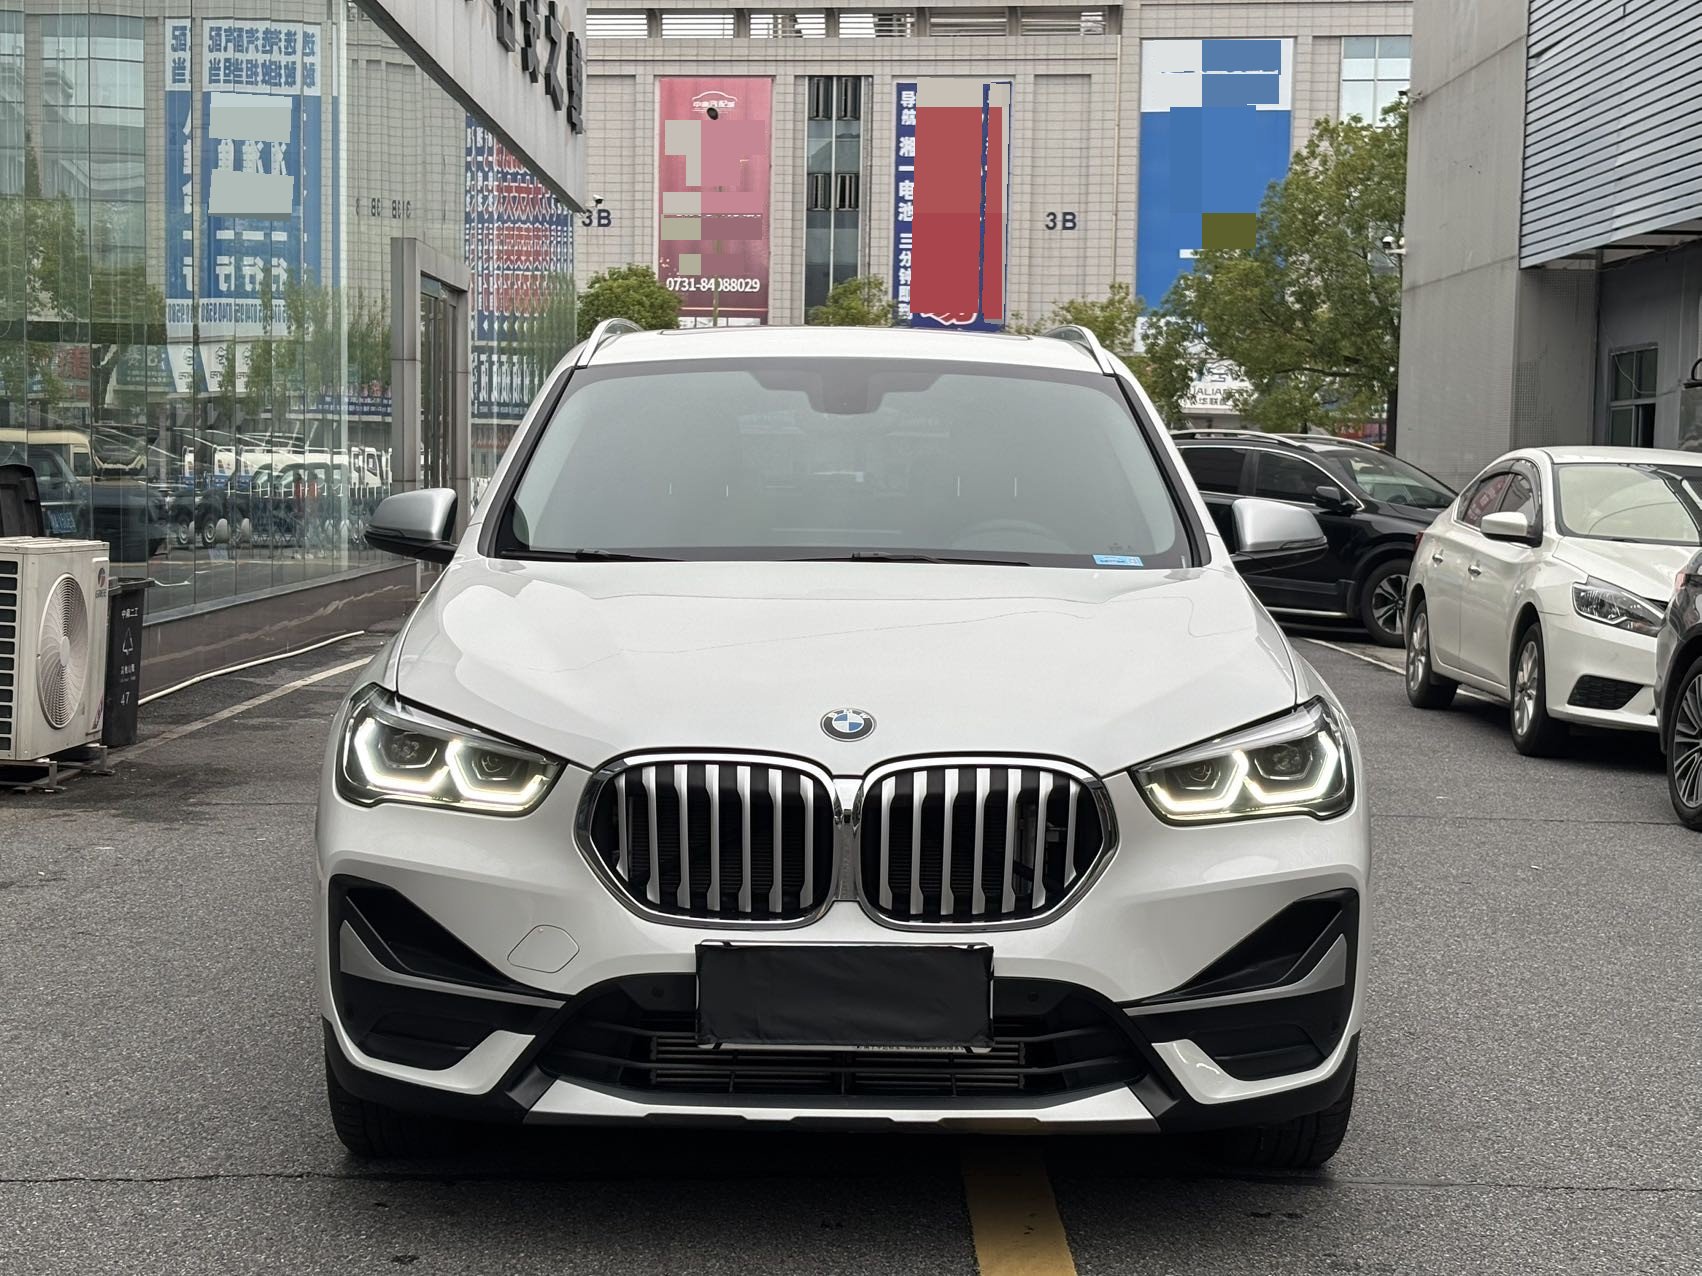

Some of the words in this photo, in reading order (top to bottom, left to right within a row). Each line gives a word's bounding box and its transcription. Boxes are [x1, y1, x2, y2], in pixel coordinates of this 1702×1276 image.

[582, 208, 612, 227] 3B
[1045, 211, 1077, 230] 3B
[120, 691, 130, 705] 47
